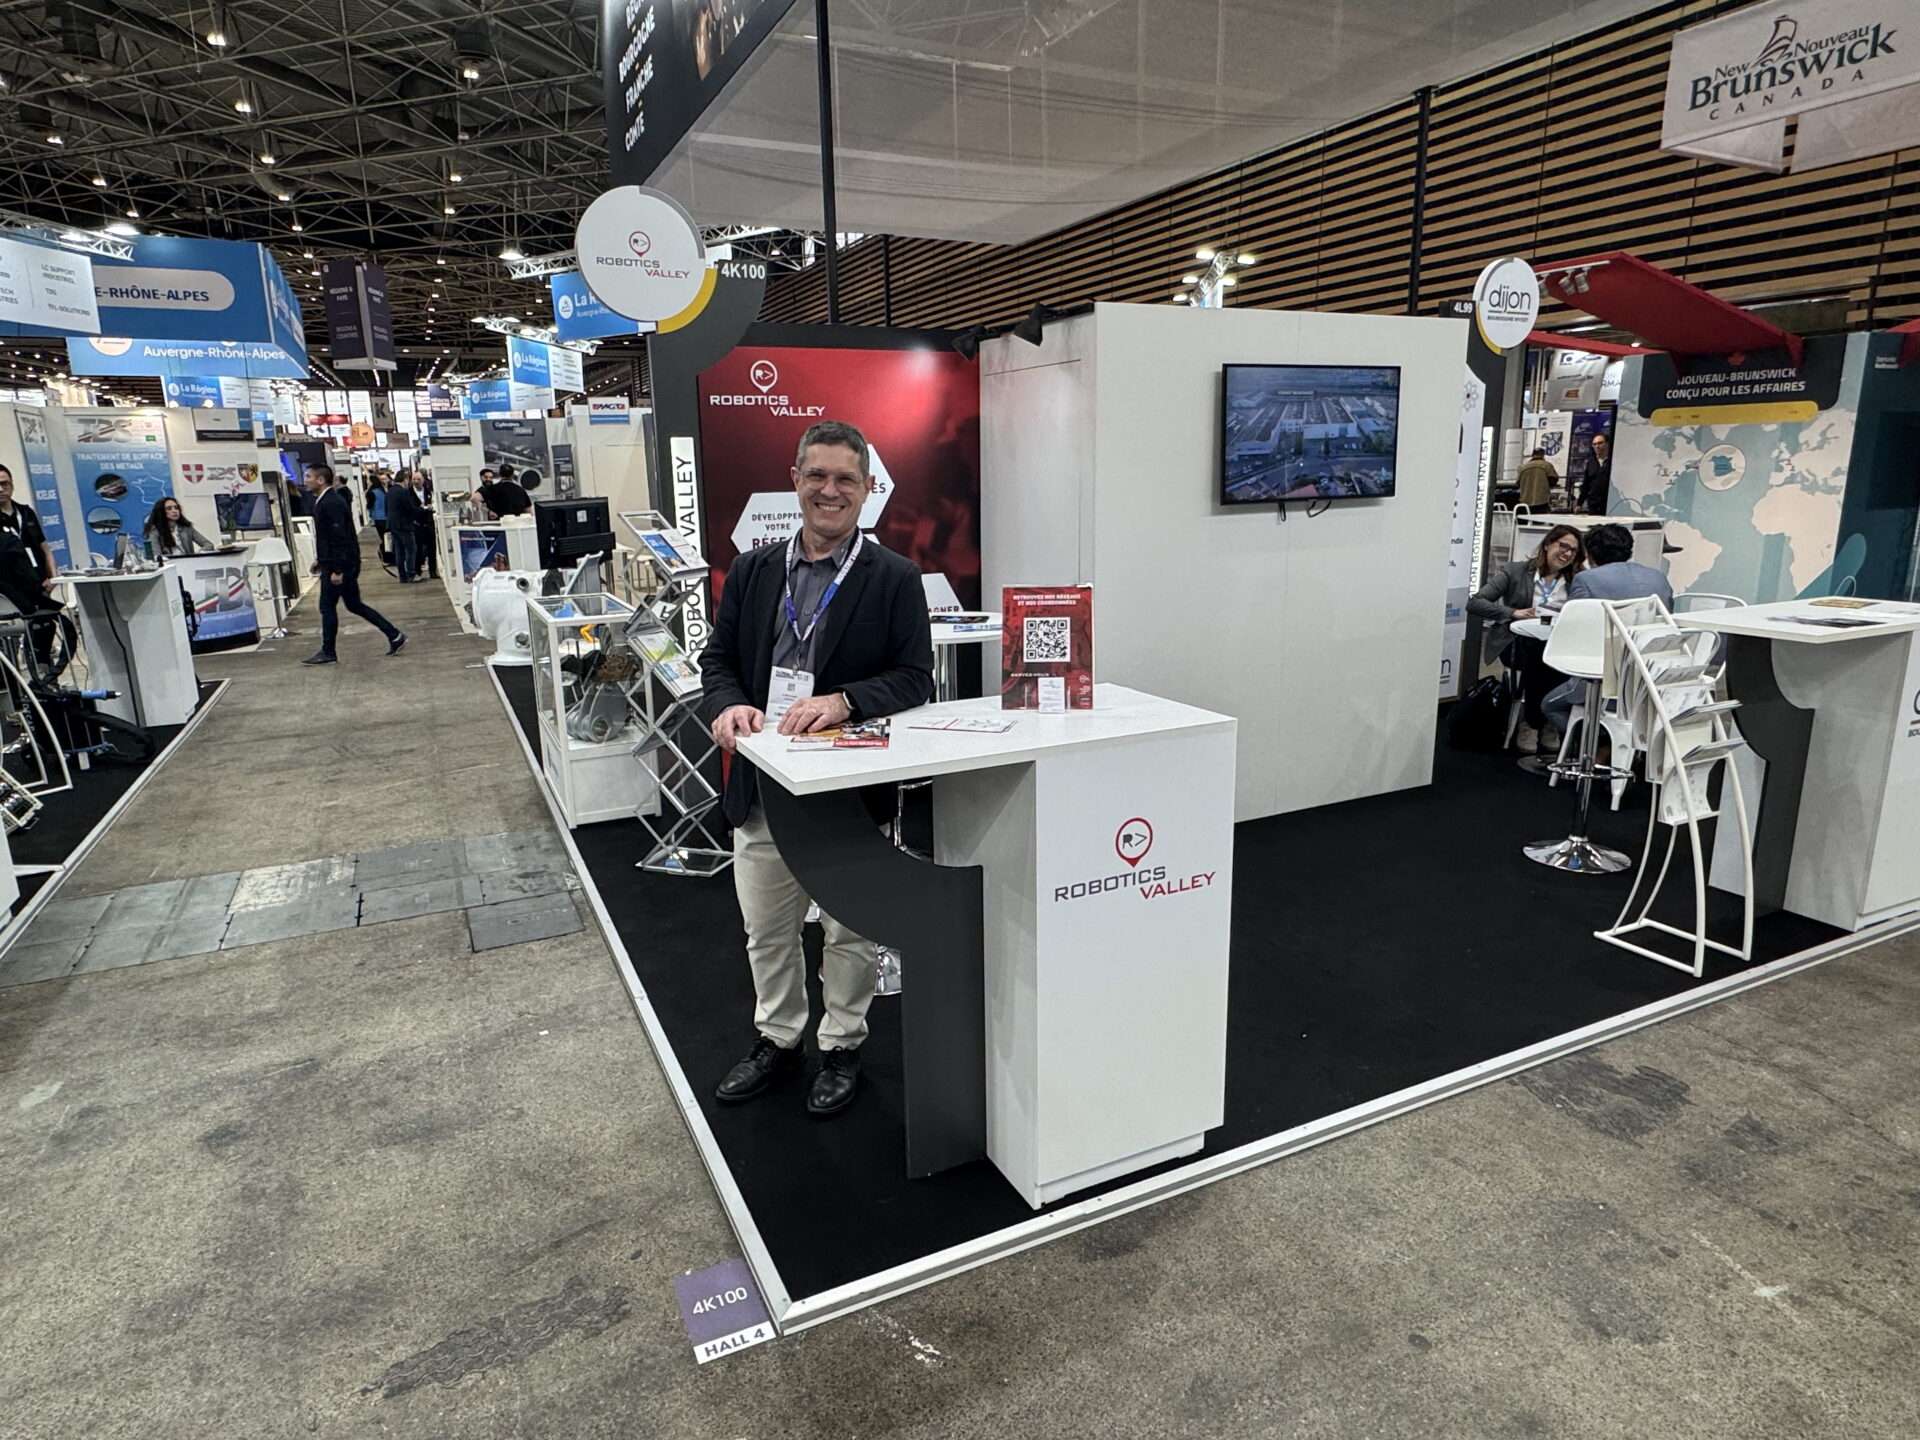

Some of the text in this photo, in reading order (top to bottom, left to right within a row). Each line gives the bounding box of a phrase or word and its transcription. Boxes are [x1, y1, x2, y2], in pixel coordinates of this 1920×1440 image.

[619, 5, 655, 83] BOURGOGNE
[1714, 25, 1869, 81] New Nouveau
[1688, 23, 1897, 111] Brunswick
[626, 54, 654, 113] FRANCHE
[1709, 68, 1864, 121] CANADA
[596, 256, 660, 269] ROBOTICS
[644, 269, 690, 280] VALLEY
[721, 262, 765, 280] 4K100
[95, 284, 209, 302] E-RHÔNE-ALPES
[1489, 284, 1531, 313] dijon
[1454, 301, 1473, 314] 4L99
[143, 345, 287, 361] Auvergne-Rhône-Alpes
[709, 394, 789, 407] ROBOTICS
[1666, 381, 1806, 400] CONÇU POUR LES AFFAIRES
[770, 405, 825, 417] VALLEY
[675, 456, 696, 537] VALLEY
[765, 522, 791, 531] VOTRE
[1055, 865, 1166, 902] ROBOTICS
[1140, 871, 1216, 900] VALLEY
[692, 1287, 748, 1315] 4K100
[704, 1328, 766, 1357] HALL 4
